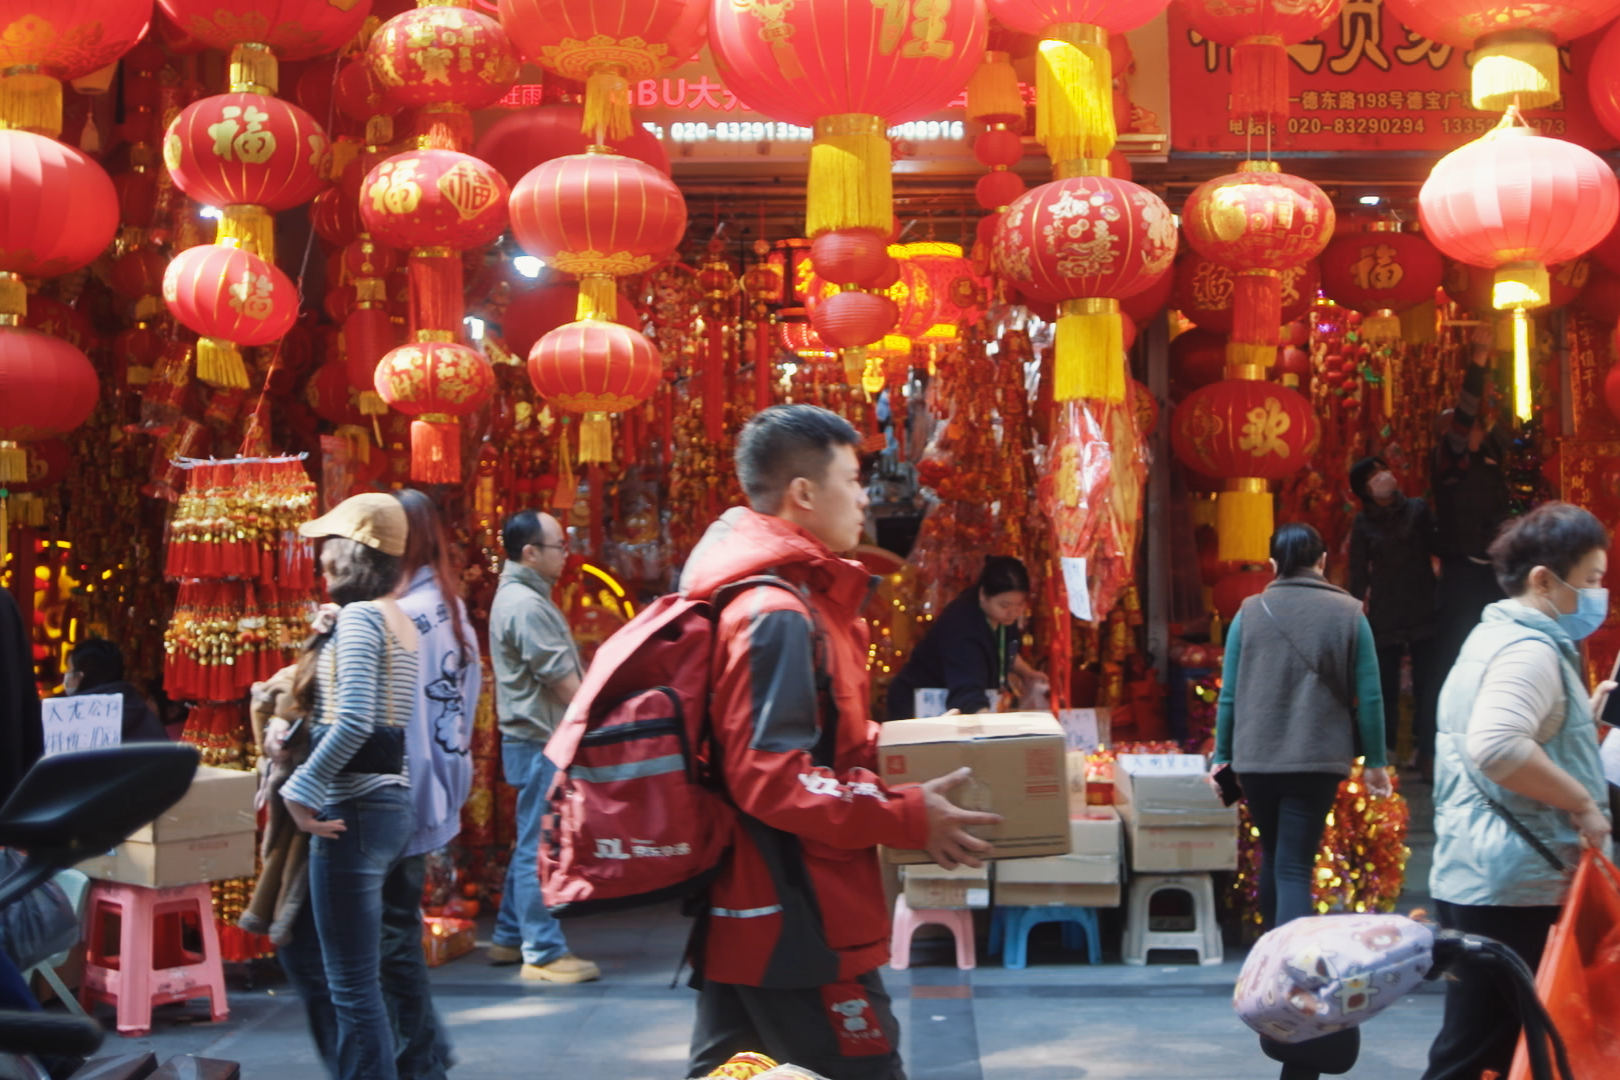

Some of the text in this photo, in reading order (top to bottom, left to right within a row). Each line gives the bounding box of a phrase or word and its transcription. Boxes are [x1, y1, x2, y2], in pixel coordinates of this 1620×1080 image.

[207, 105, 277, 164] 福
[1288, 118, 1425, 135] 020-83290294
[369, 158, 422, 215] 福
[1350, 243, 1404, 290] 福
[228, 270, 274, 320] 福
